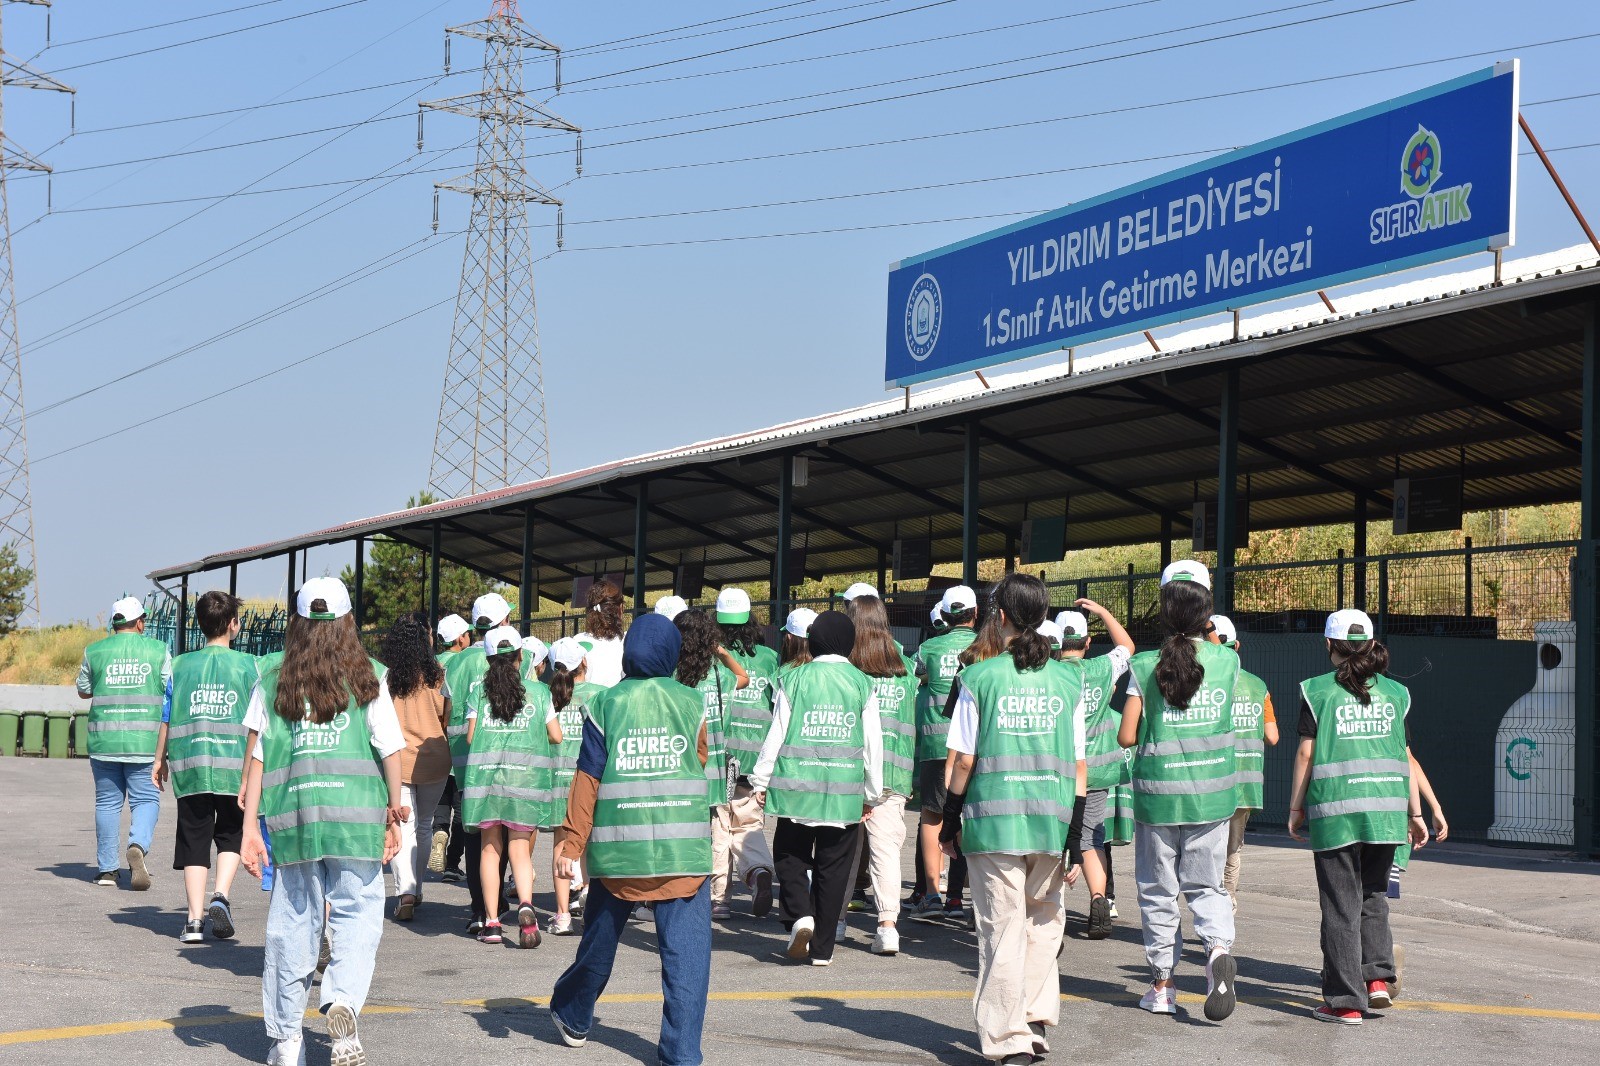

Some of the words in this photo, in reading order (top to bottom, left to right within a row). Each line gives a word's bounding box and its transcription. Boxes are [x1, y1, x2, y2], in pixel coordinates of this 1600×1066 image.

[1007, 221, 1111, 285] YILDIRIM
[1117, 155, 1282, 256] BELEDİYESİ
[1047, 286, 1094, 333] Atık
[1098, 269, 1198, 319] Getirme
[1204, 225, 1313, 294] Merkezi
[106, 663, 139, 677] ÇEVRE
[190, 690, 225, 706] ÇEVRE
[997, 695, 1048, 717] ÇEVRE
[803, 711, 844, 728] ÇEVRE
[1335, 702, 1382, 725] ÇEVRE
[628, 726, 668, 736] YILDIRIM
[997, 714, 1057, 731] MÜFETTİŞİ
[1336, 719, 1392, 736] MÜFETTİŞİ
[617, 735, 670, 758] ÇEVRE
[615, 754, 682, 771] MÜFETTİŞİ
